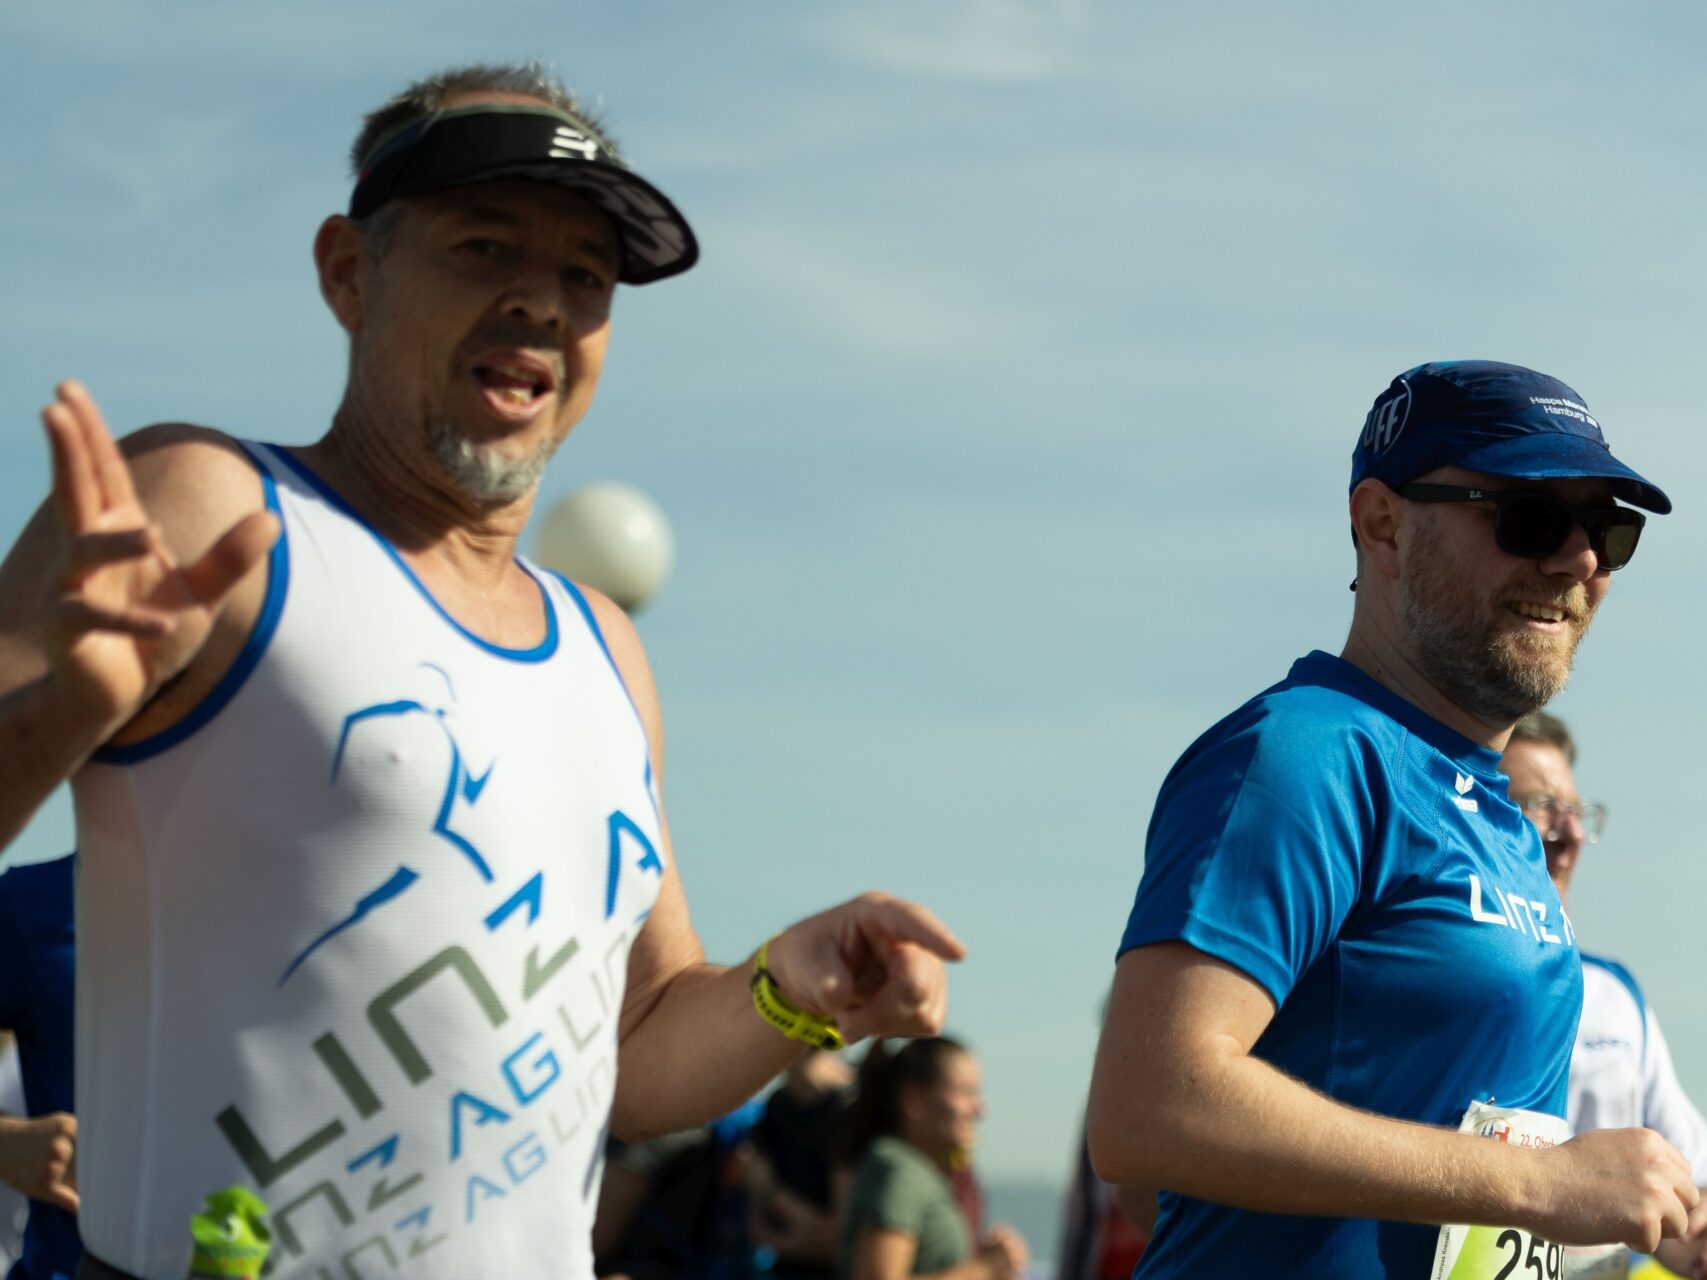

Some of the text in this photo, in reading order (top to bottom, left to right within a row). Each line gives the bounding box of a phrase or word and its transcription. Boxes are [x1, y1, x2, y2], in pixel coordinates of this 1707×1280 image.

[1529, 396, 1563, 406] Haspa
[1543, 405, 1585, 423] Hamburg
[604, 810, 663, 922] A
[449, 1031, 562, 1163] AG
[466, 1132, 547, 1224] AG
[1436, 1256, 1446, 1280] Andreas
